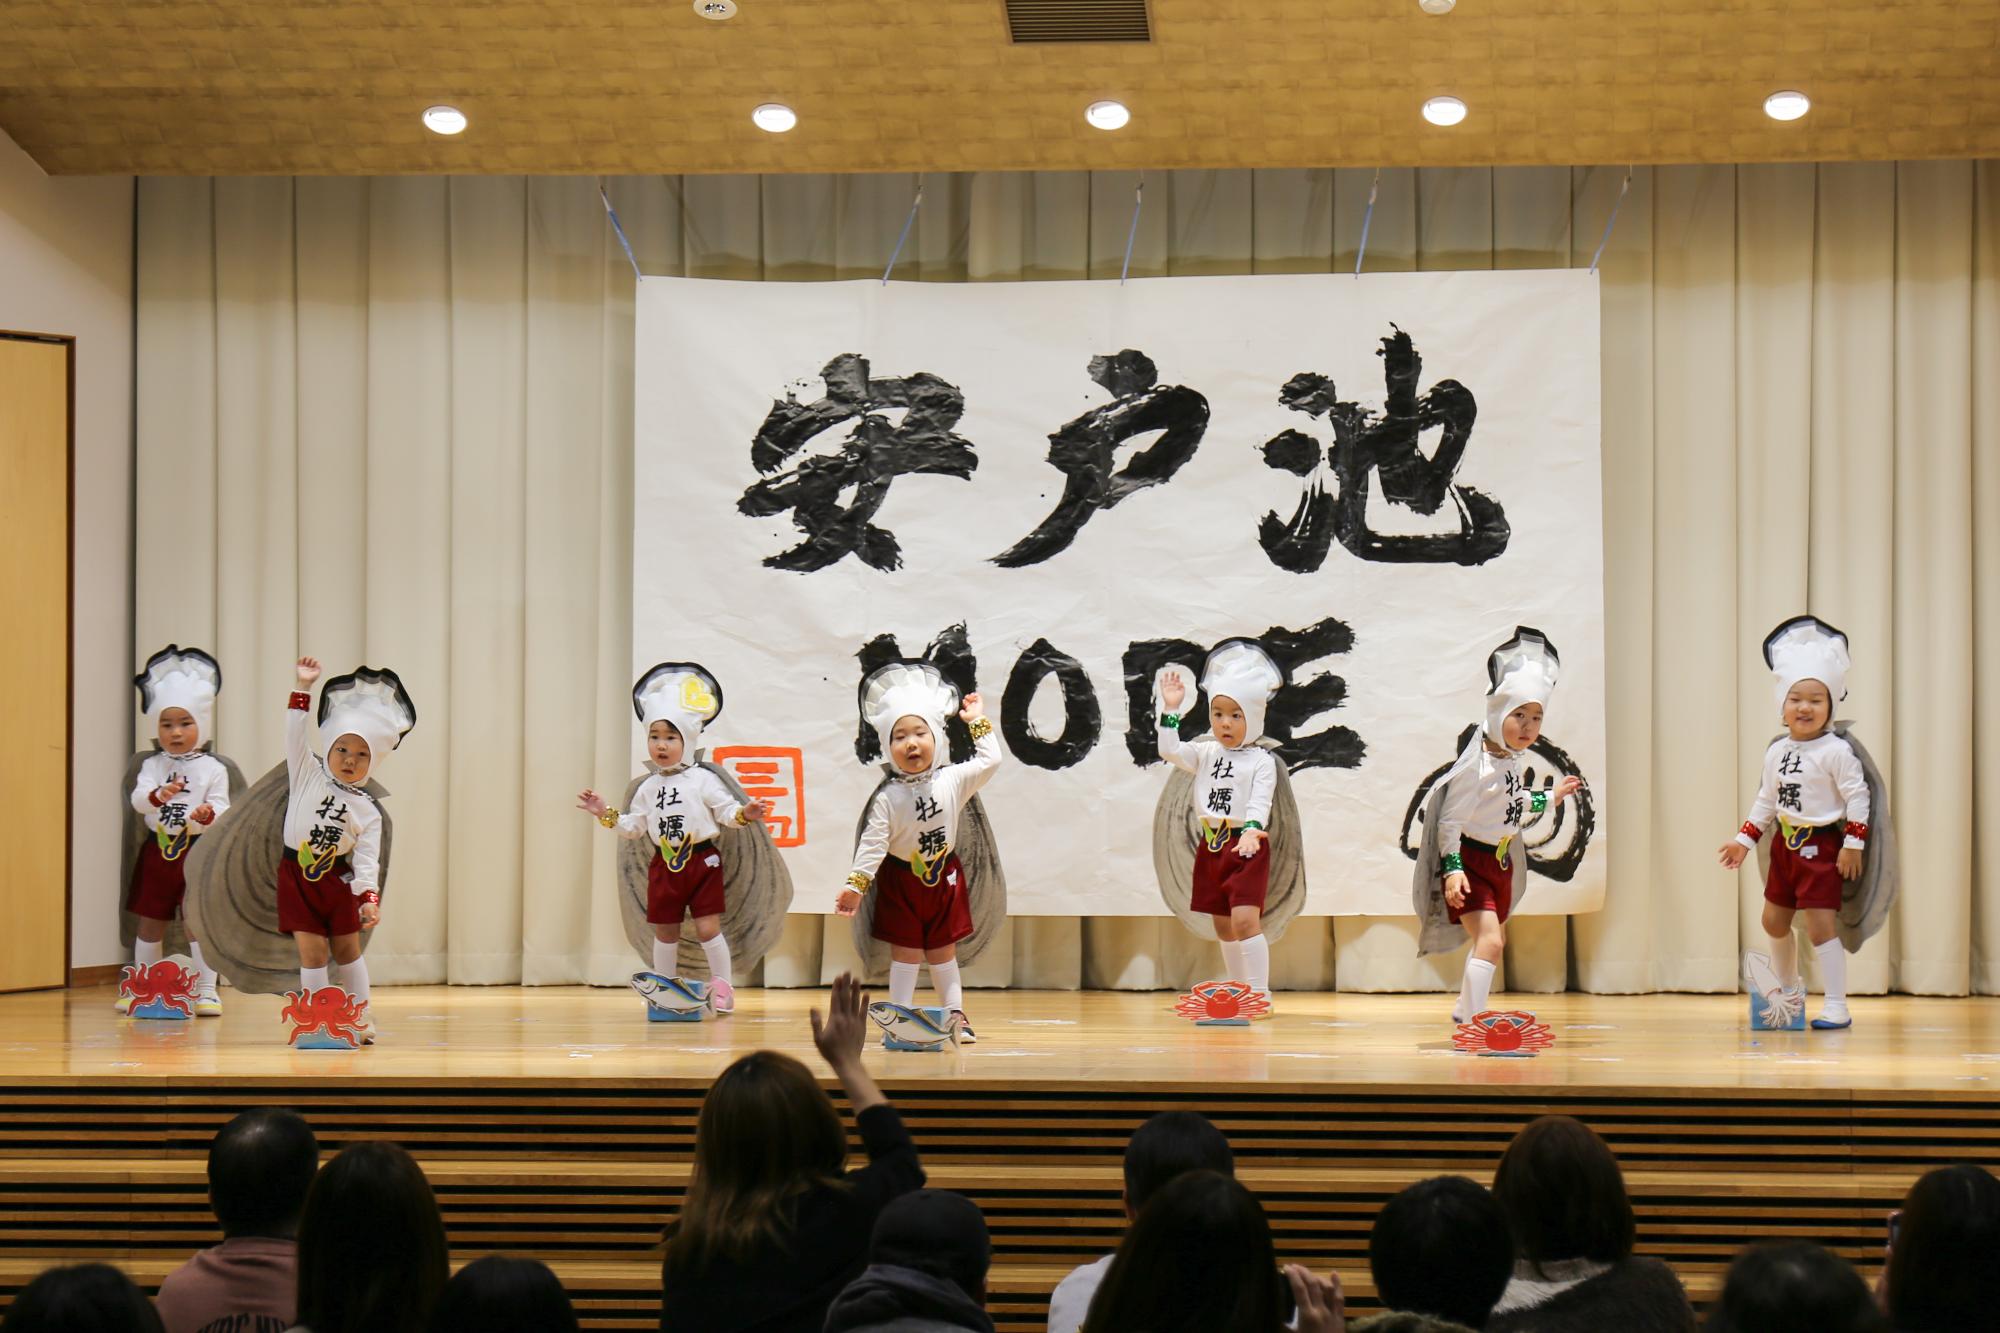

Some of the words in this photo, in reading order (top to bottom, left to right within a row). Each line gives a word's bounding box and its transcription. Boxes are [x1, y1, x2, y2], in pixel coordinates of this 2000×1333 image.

[1207, 756, 1235, 815] 牡蠣
[1778, 751, 1803, 812] 牡蠣
[307, 795, 348, 851] 牡蠣
[655, 786, 685, 841] 牡蠣
[915, 796, 948, 857] 牡蠣
